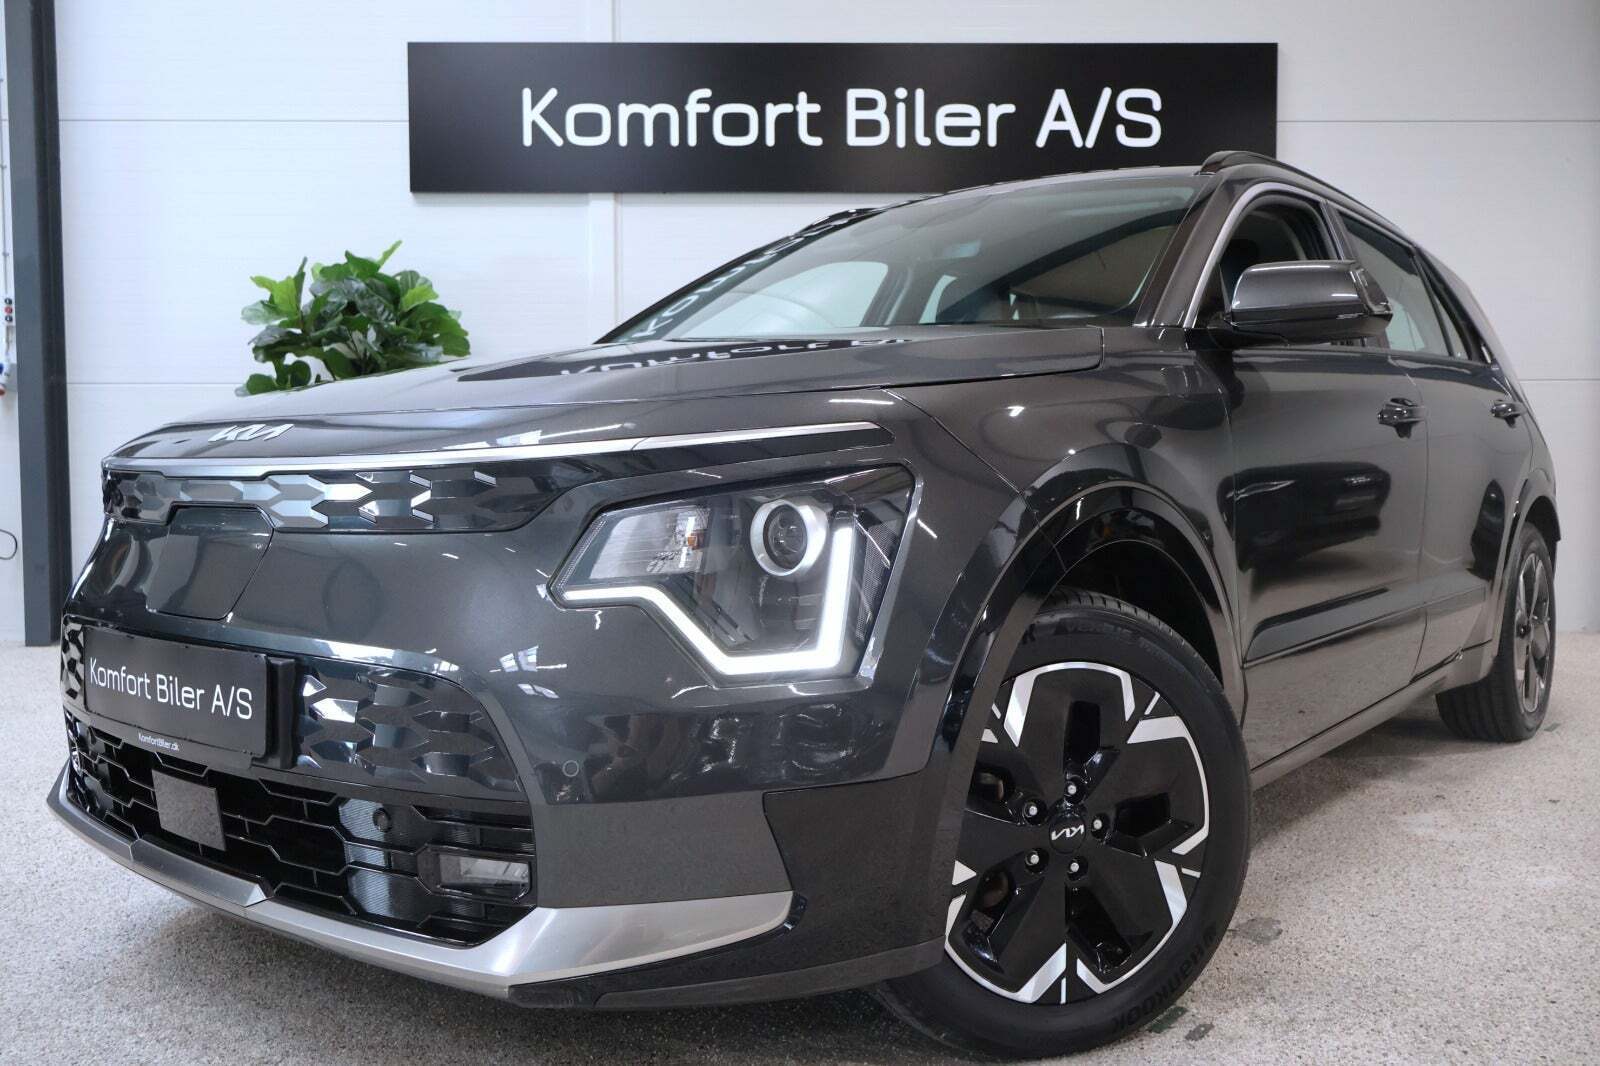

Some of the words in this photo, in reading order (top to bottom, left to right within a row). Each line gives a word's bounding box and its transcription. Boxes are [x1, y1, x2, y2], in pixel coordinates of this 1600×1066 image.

[521, 86, 824, 148] Komfort
[846, 86, 1017, 149] Biler
[1035, 86, 1163, 148] A/S
[208, 423, 295, 442] KIA
[89, 656, 152, 701] Komfort
[156, 673, 206, 711] Biler
[210, 683, 253, 720] A/S
[1051, 824, 1085, 841] KIA
